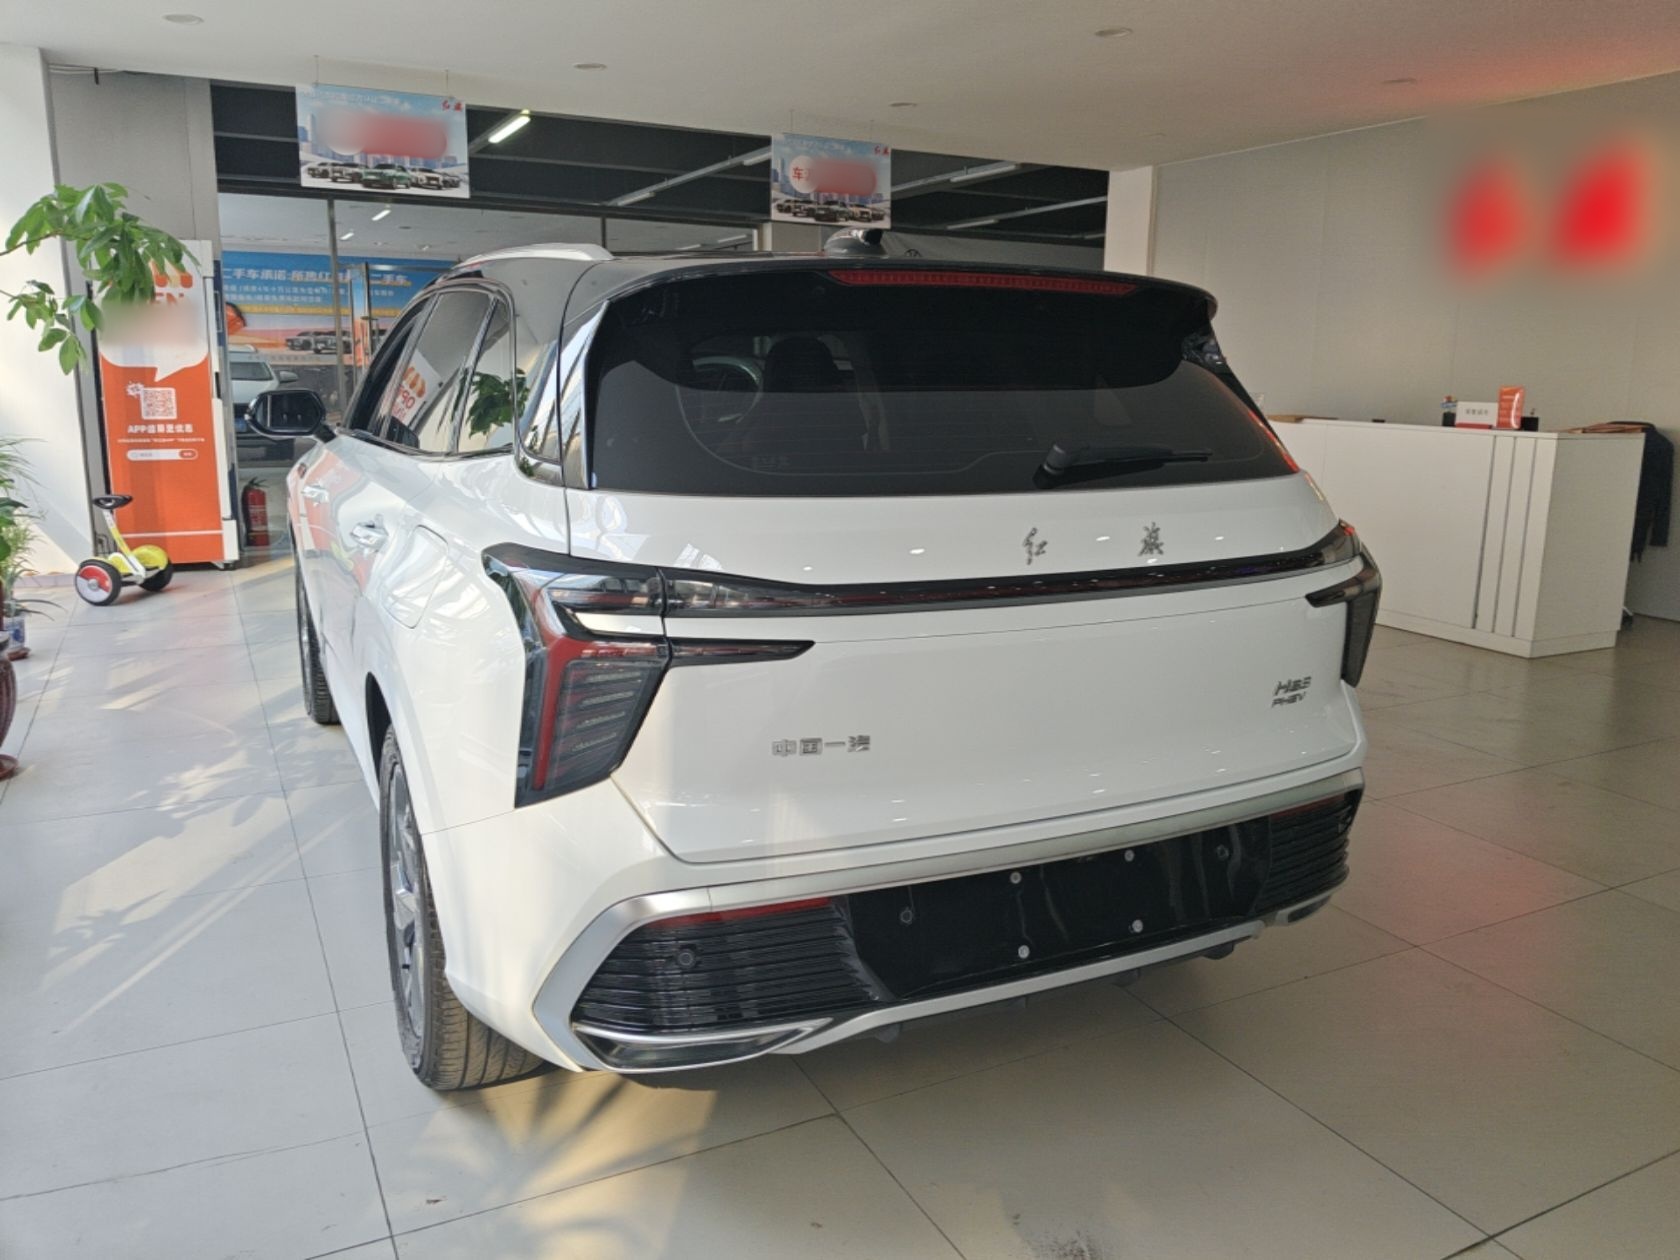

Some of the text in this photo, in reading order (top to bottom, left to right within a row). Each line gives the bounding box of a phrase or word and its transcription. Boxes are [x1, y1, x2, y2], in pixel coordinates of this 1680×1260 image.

[1023, 521, 1165, 566] 红旗
[771, 735, 871, 757] 中国一汽
